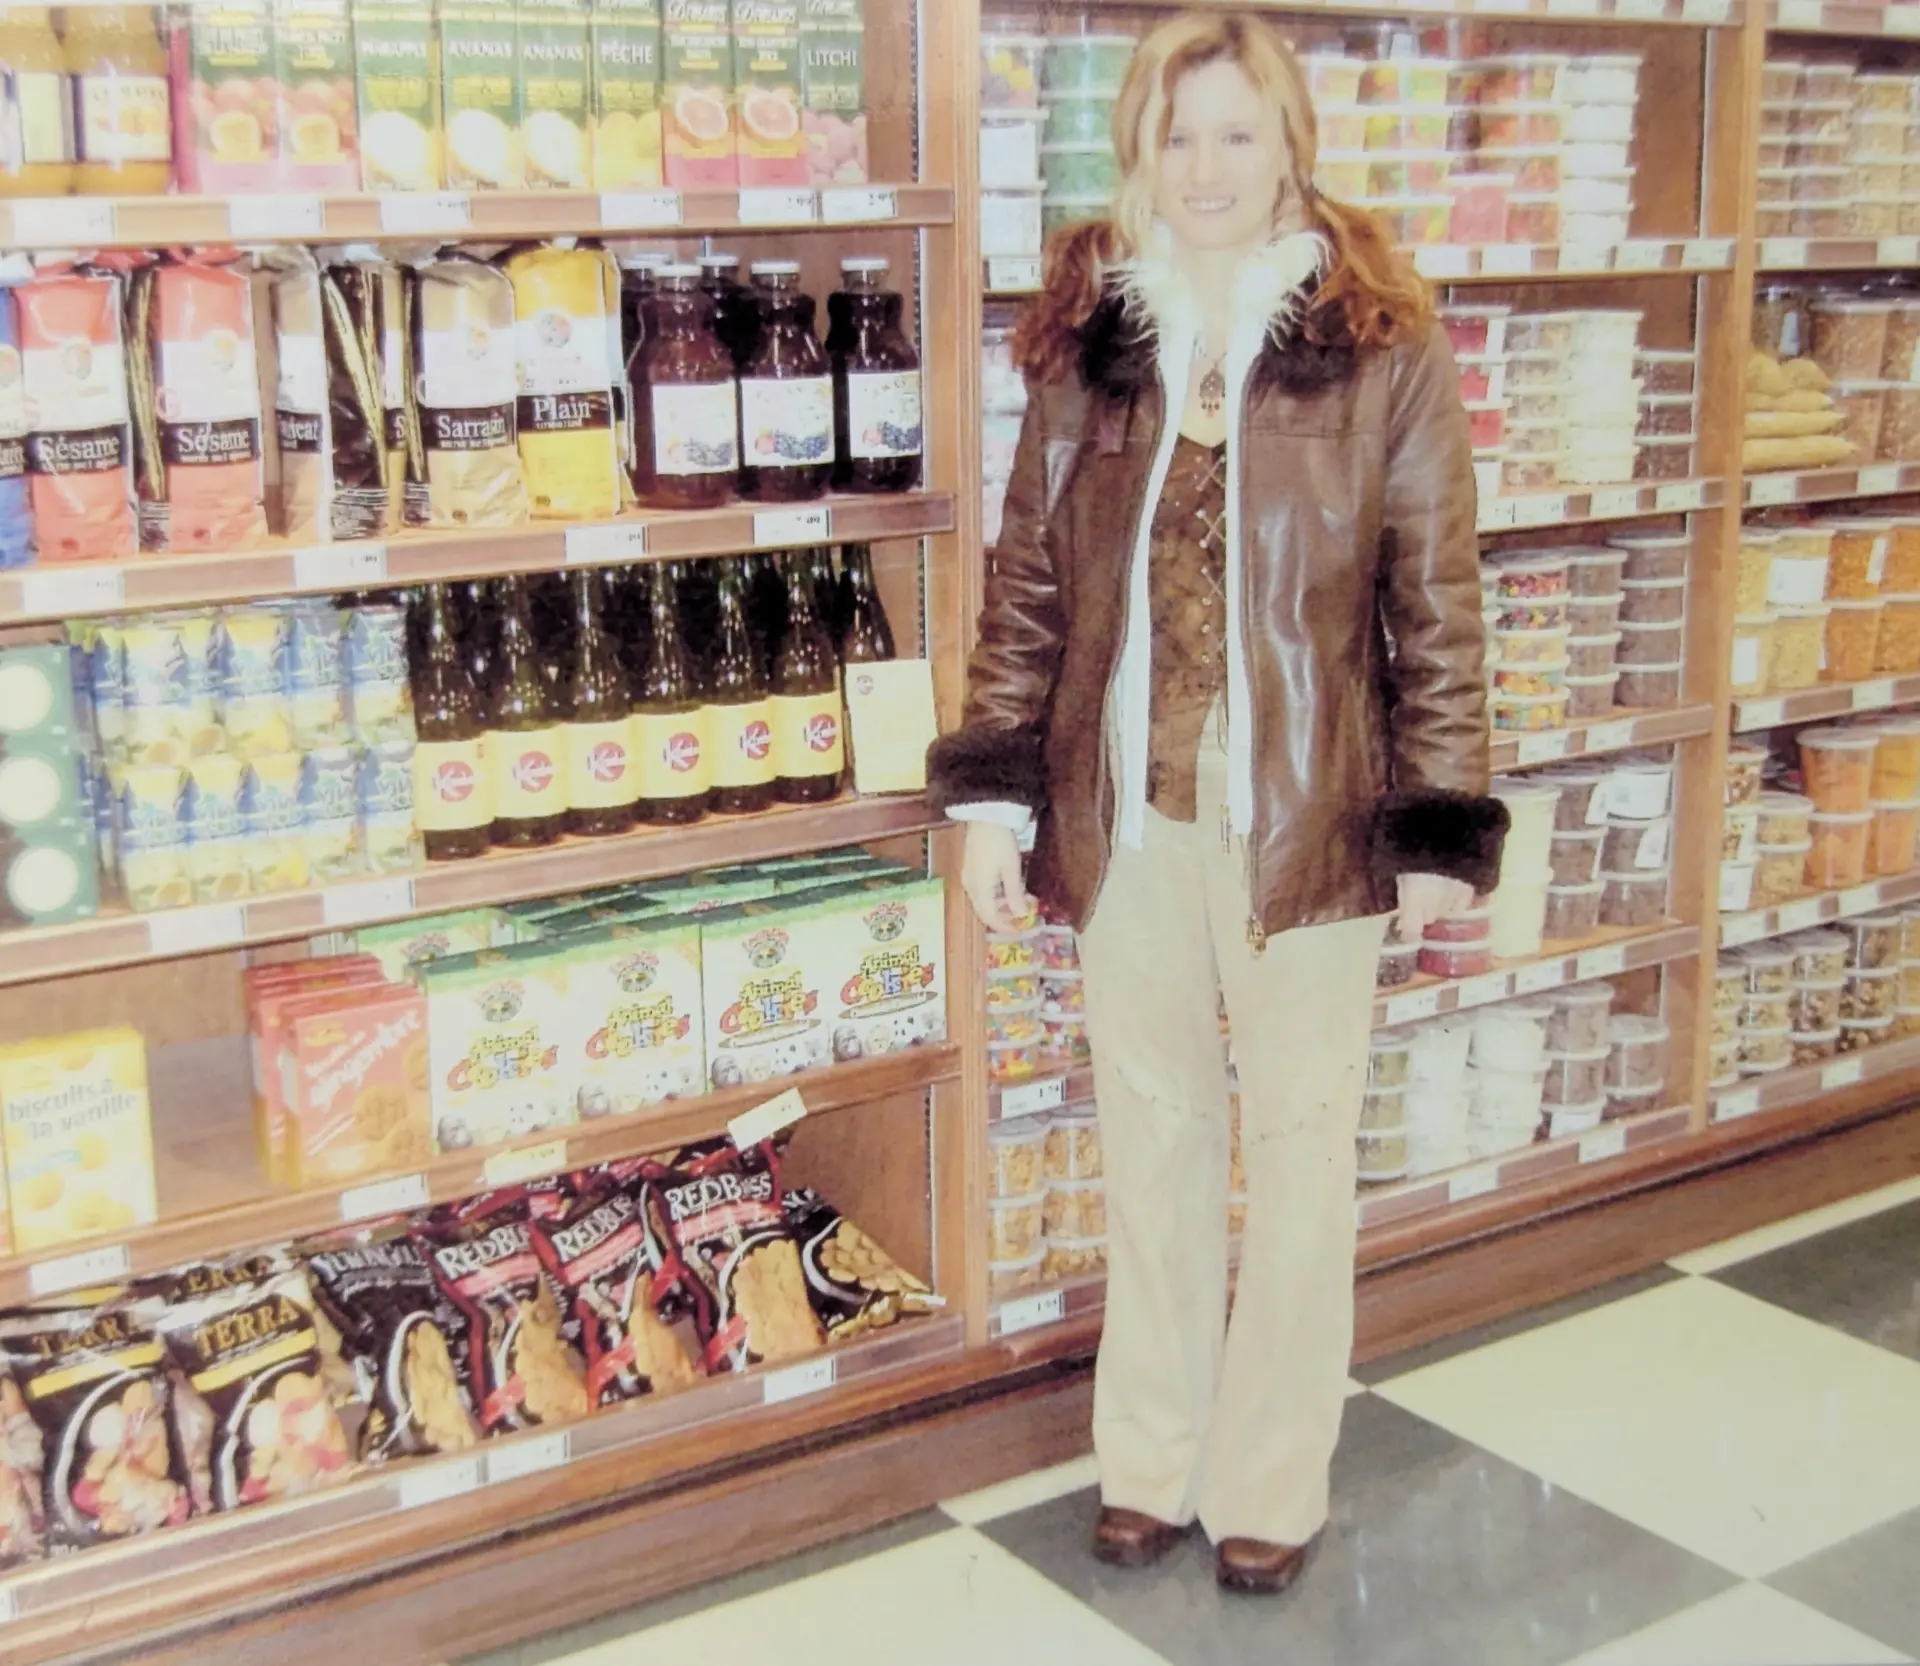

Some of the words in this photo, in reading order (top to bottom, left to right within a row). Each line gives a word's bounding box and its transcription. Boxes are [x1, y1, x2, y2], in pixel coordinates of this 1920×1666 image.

[807, 48, 858, 67] LITCHI
[533, 396, 592, 422] Plain
[8, 1083, 98, 1123] biscuits
[194, 1296, 300, 1359] TERRA
